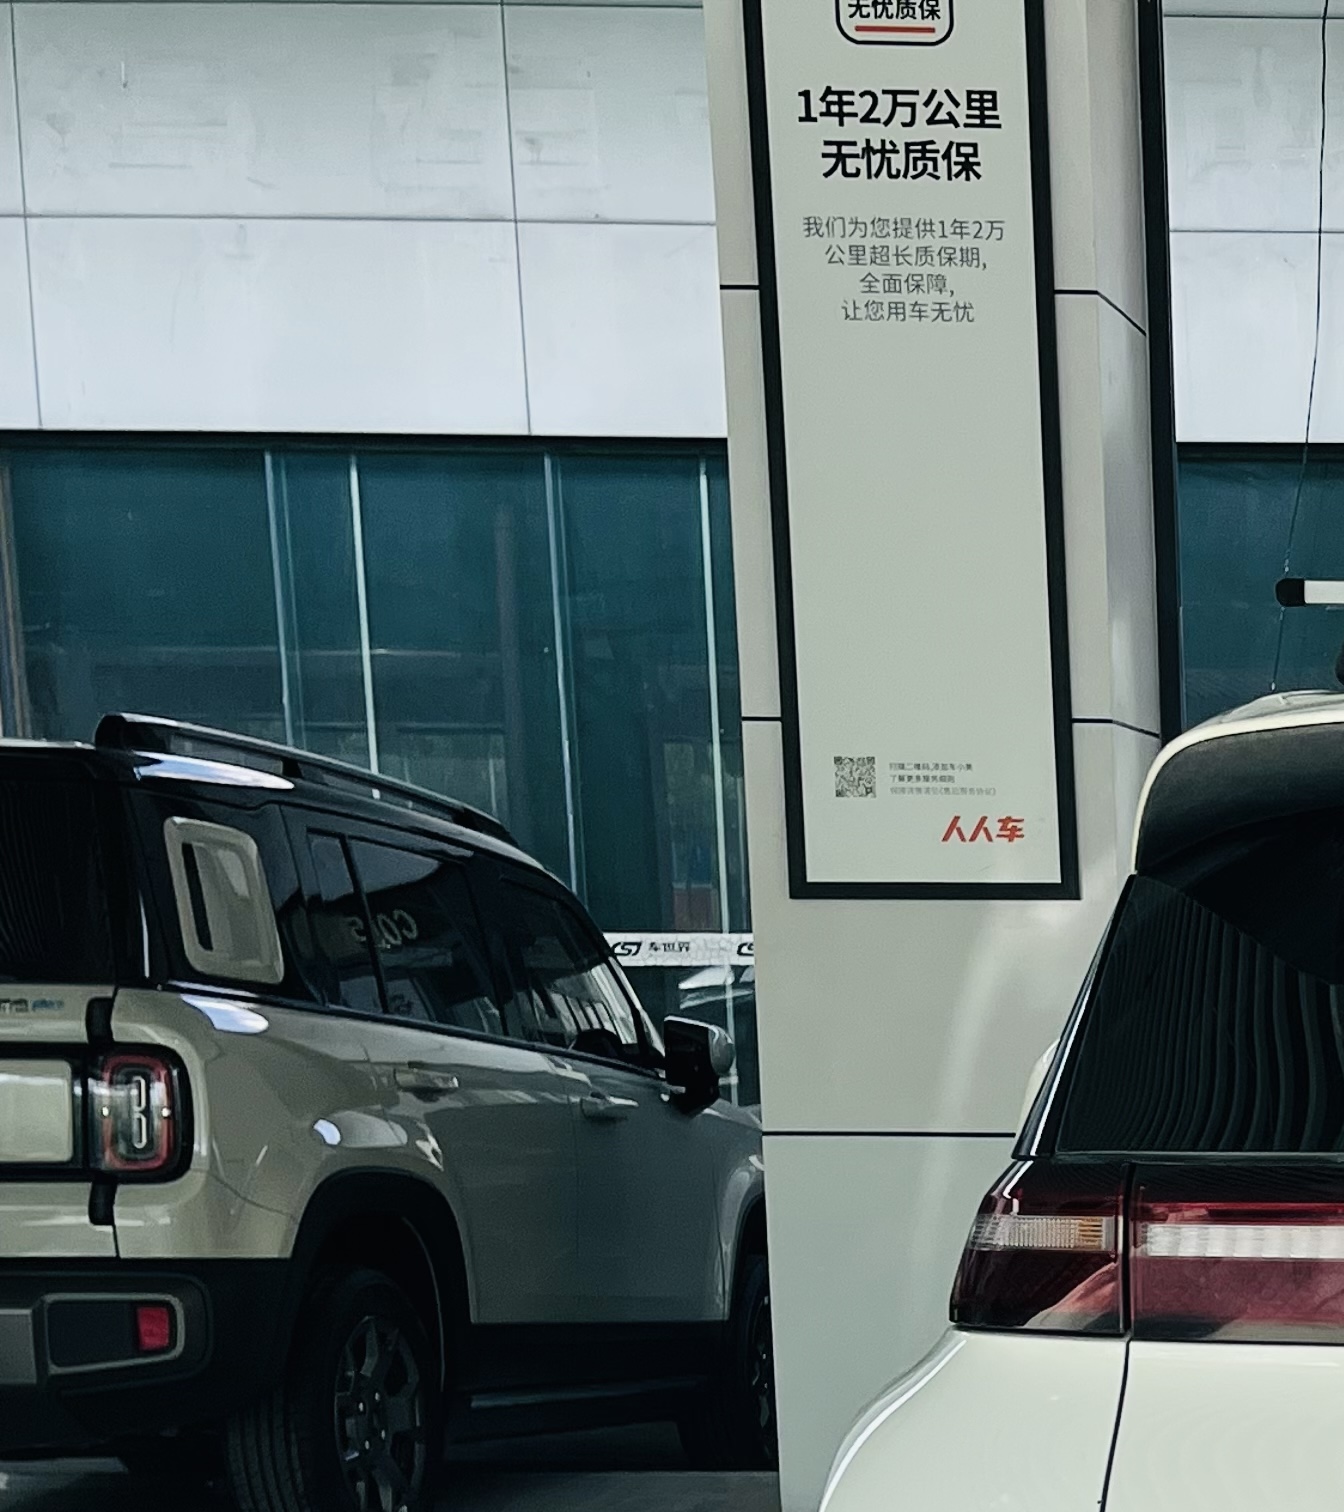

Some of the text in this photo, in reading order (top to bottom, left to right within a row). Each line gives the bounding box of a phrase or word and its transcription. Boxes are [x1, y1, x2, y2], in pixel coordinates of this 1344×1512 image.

[797, 85, 1002, 129] 1年2万公里
[820, 138, 982, 182] 无忧质保
[802, 215, 1005, 241] 我们为您提供1年2万
[840, 299, 975, 323] 让您用车无忧
[941, 815, 1025, 843] 人人车
